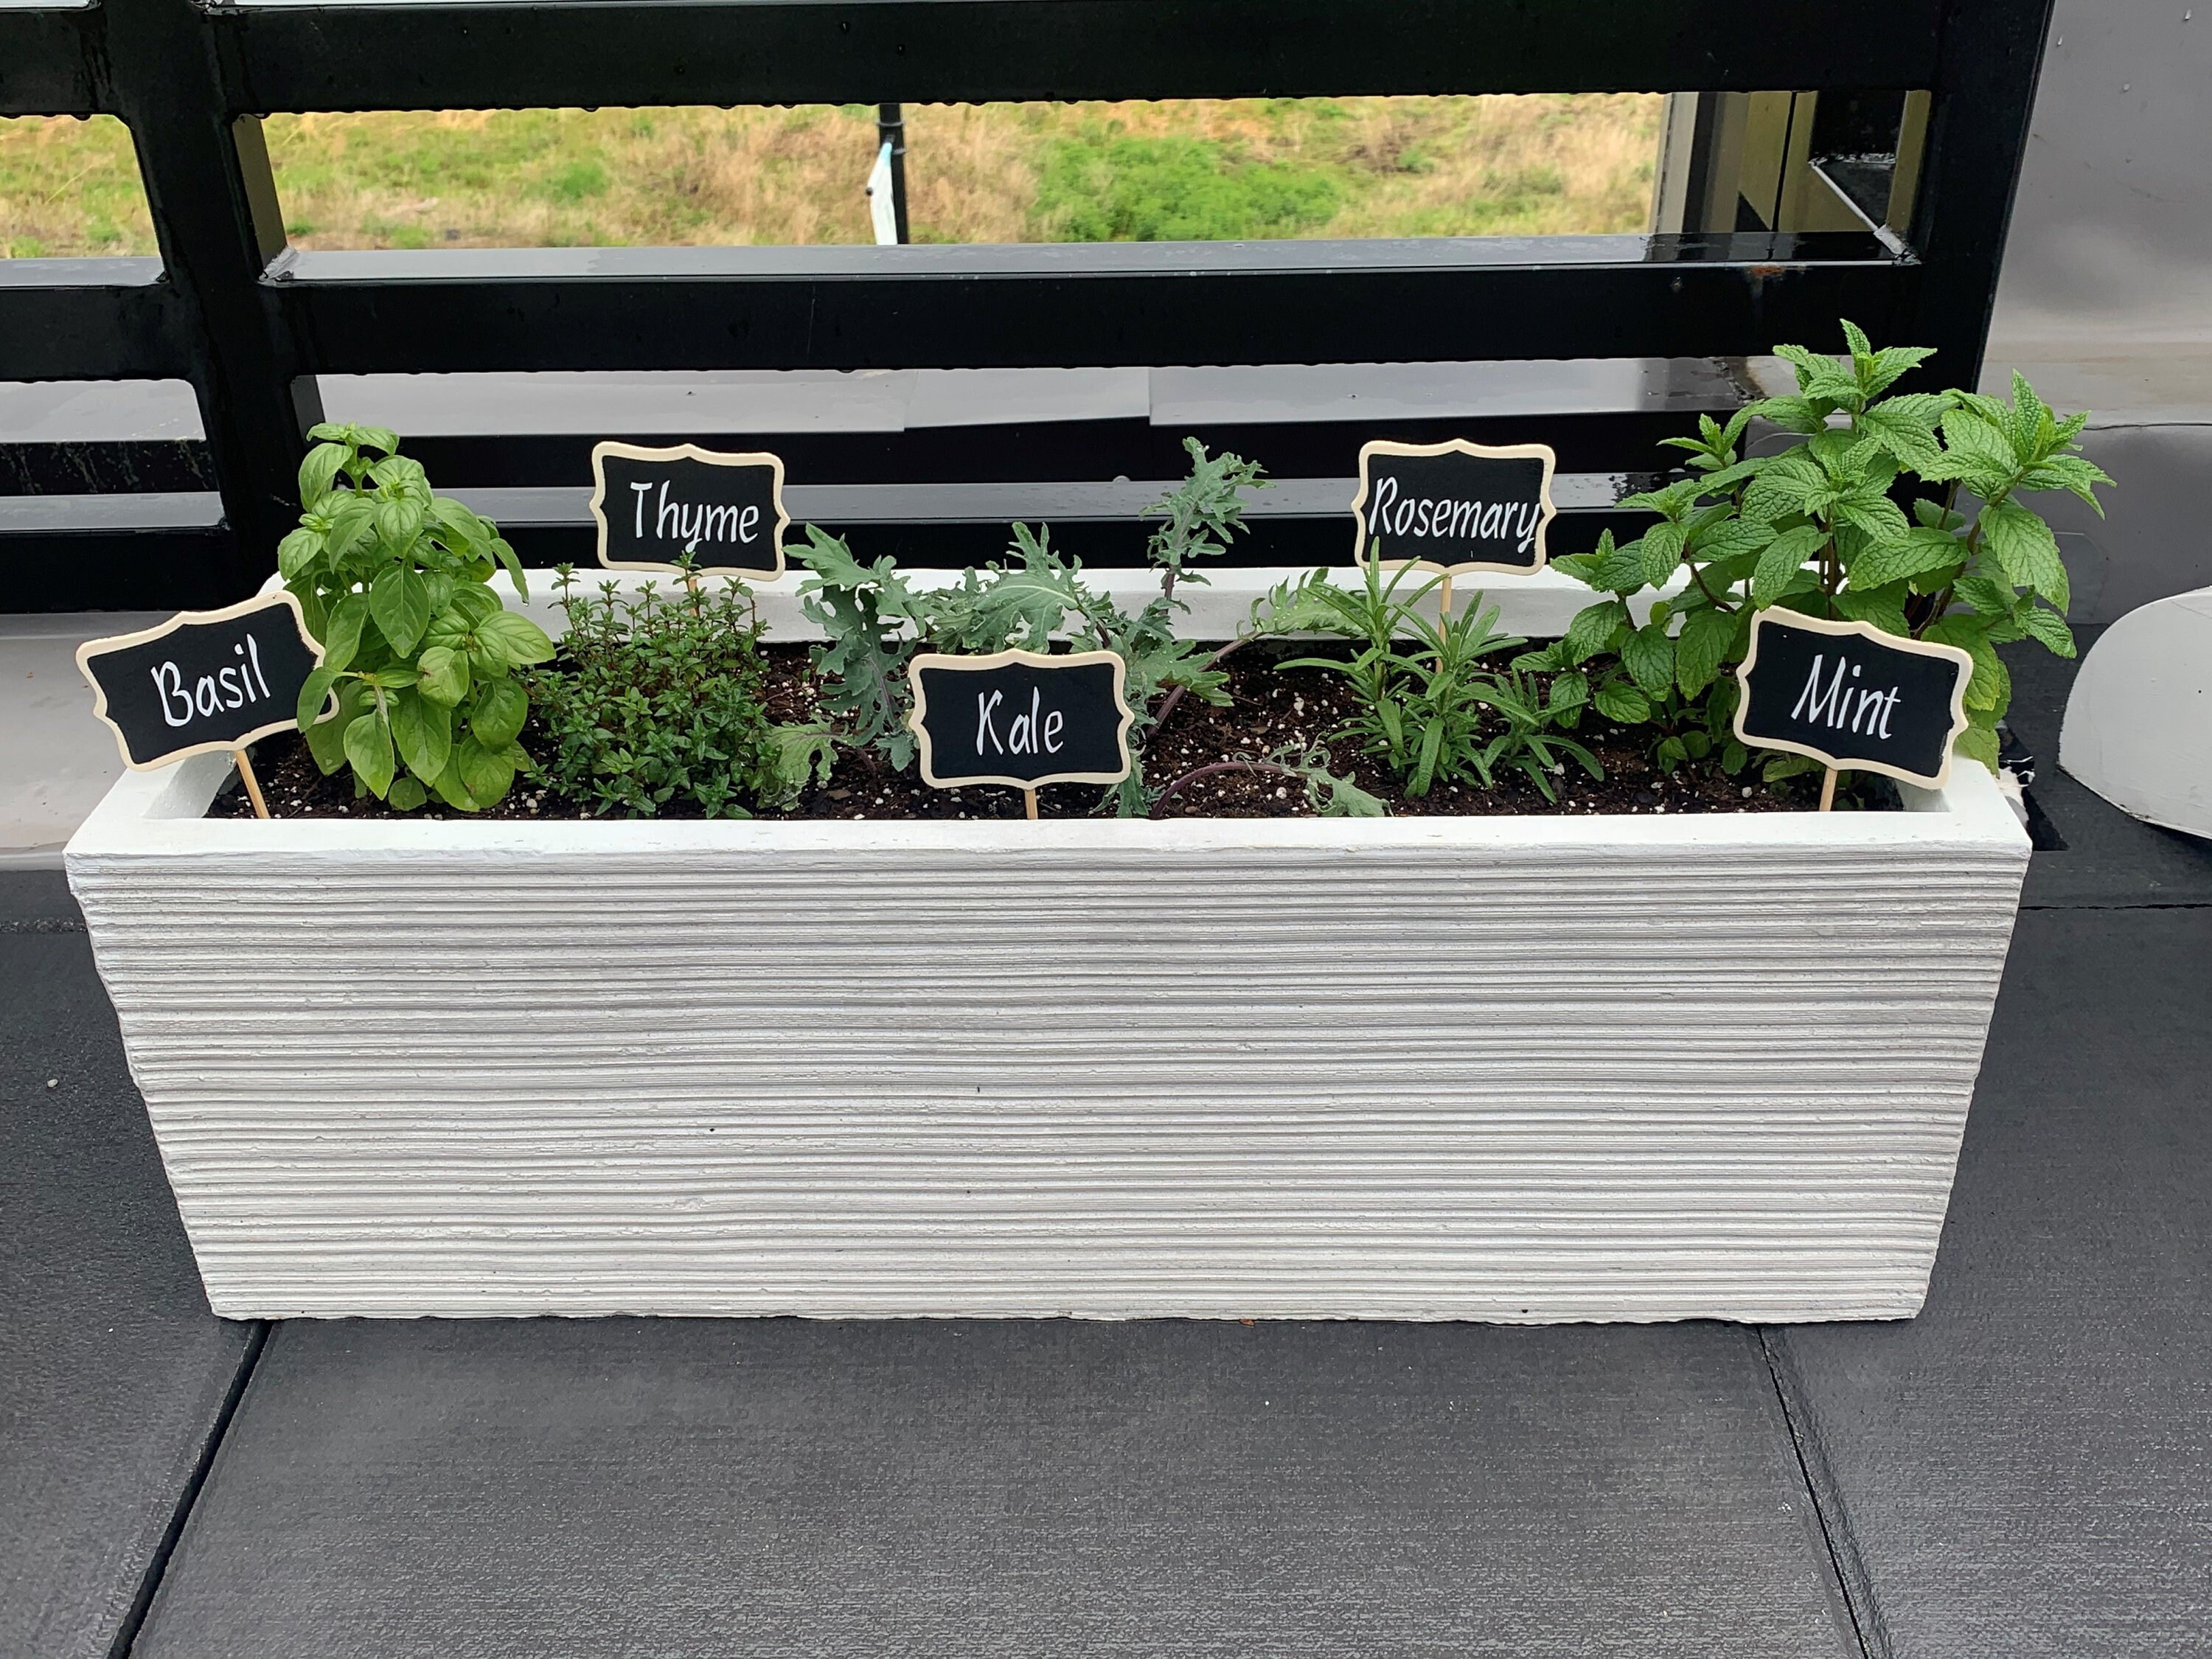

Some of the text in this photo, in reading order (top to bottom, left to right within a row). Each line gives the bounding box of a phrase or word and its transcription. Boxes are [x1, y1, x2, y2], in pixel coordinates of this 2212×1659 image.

[630, 479, 759, 554] Thyme
[1368, 476, 1540, 554] Rosemary
[150, 633, 271, 727] Basil
[1791, 654, 1902, 740] Mint
[977, 686, 1063, 756] Kale
